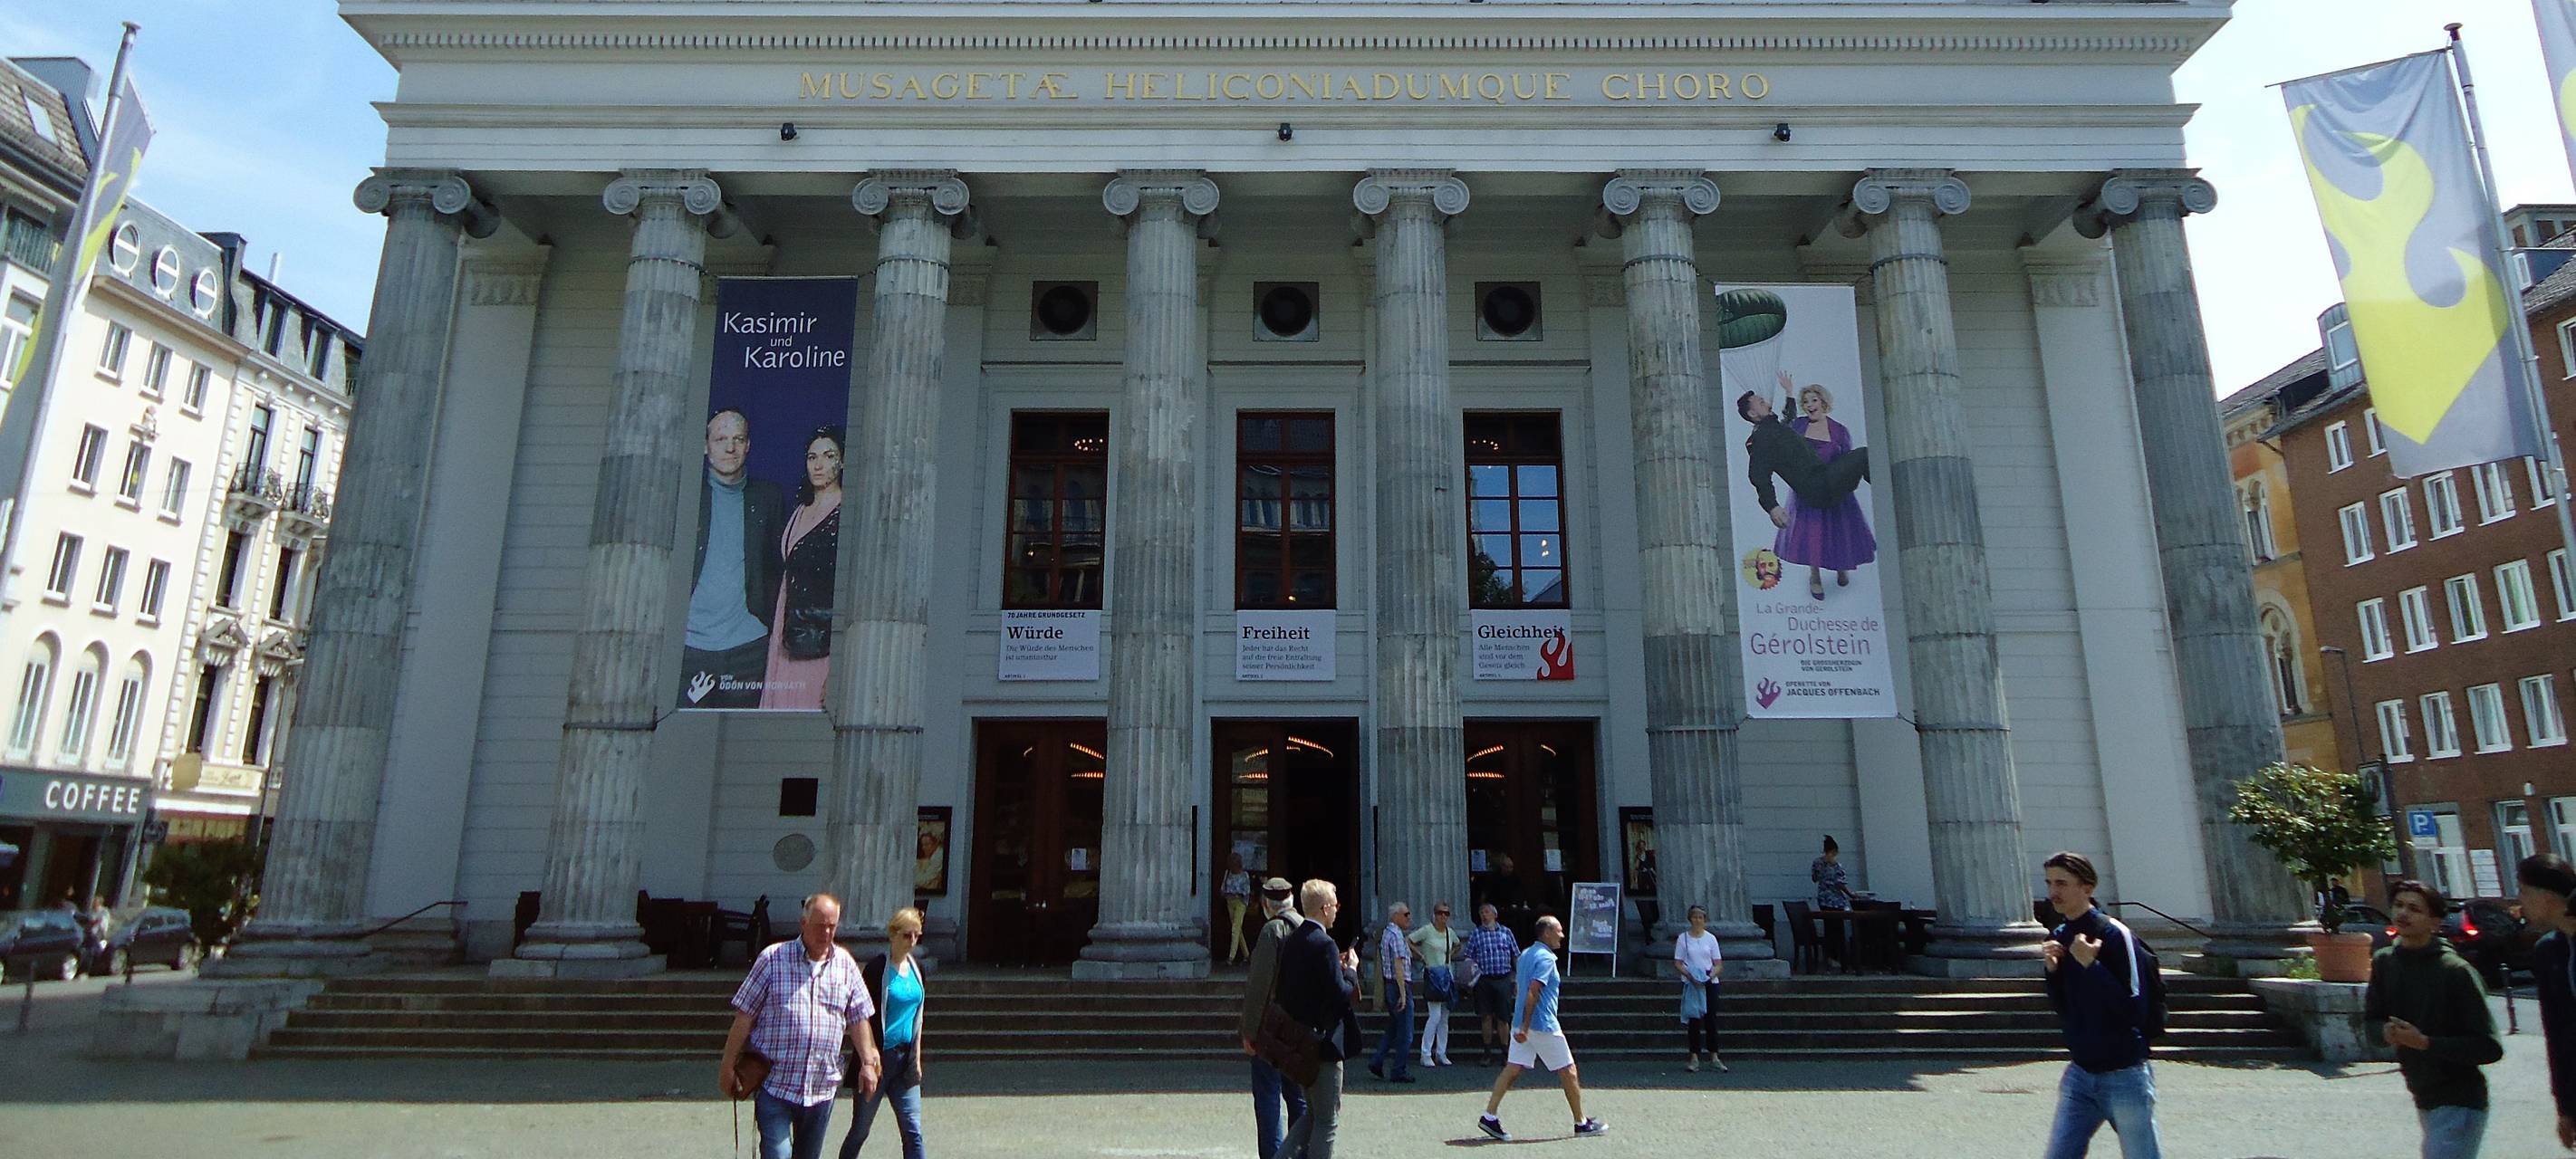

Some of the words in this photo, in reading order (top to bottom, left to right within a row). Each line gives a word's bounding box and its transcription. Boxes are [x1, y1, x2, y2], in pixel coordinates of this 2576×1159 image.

[798, 72, 1078, 101] MUSAGETÆ
[1104, 72, 1572, 104] HELICONIADUMQUE
[1601, 72, 1770, 101] CHORO
[724, 311, 817, 334] Kasimir
[770, 335, 793, 347] und
[745, 345, 845, 369] Karoline
[1756, 603, 1773, 615] La
[1775, 602, 1824, 615] Grande-
[1788, 617, 1859, 632] Duchesse
[1860, 617, 1879, 632] de
[1007, 626, 1063, 639] Würde
[1242, 626, 1311, 639] Freiheit
[1751, 632, 1871, 656] Gérolstein
[745, 681, 764, 690] VON
[1786, 688, 1826, 696] JACQUES
[1828, 688, 1880, 696] OFFENBACH
[46, 780, 141, 814] COFFEE
[2413, 814, 2428, 833] P
